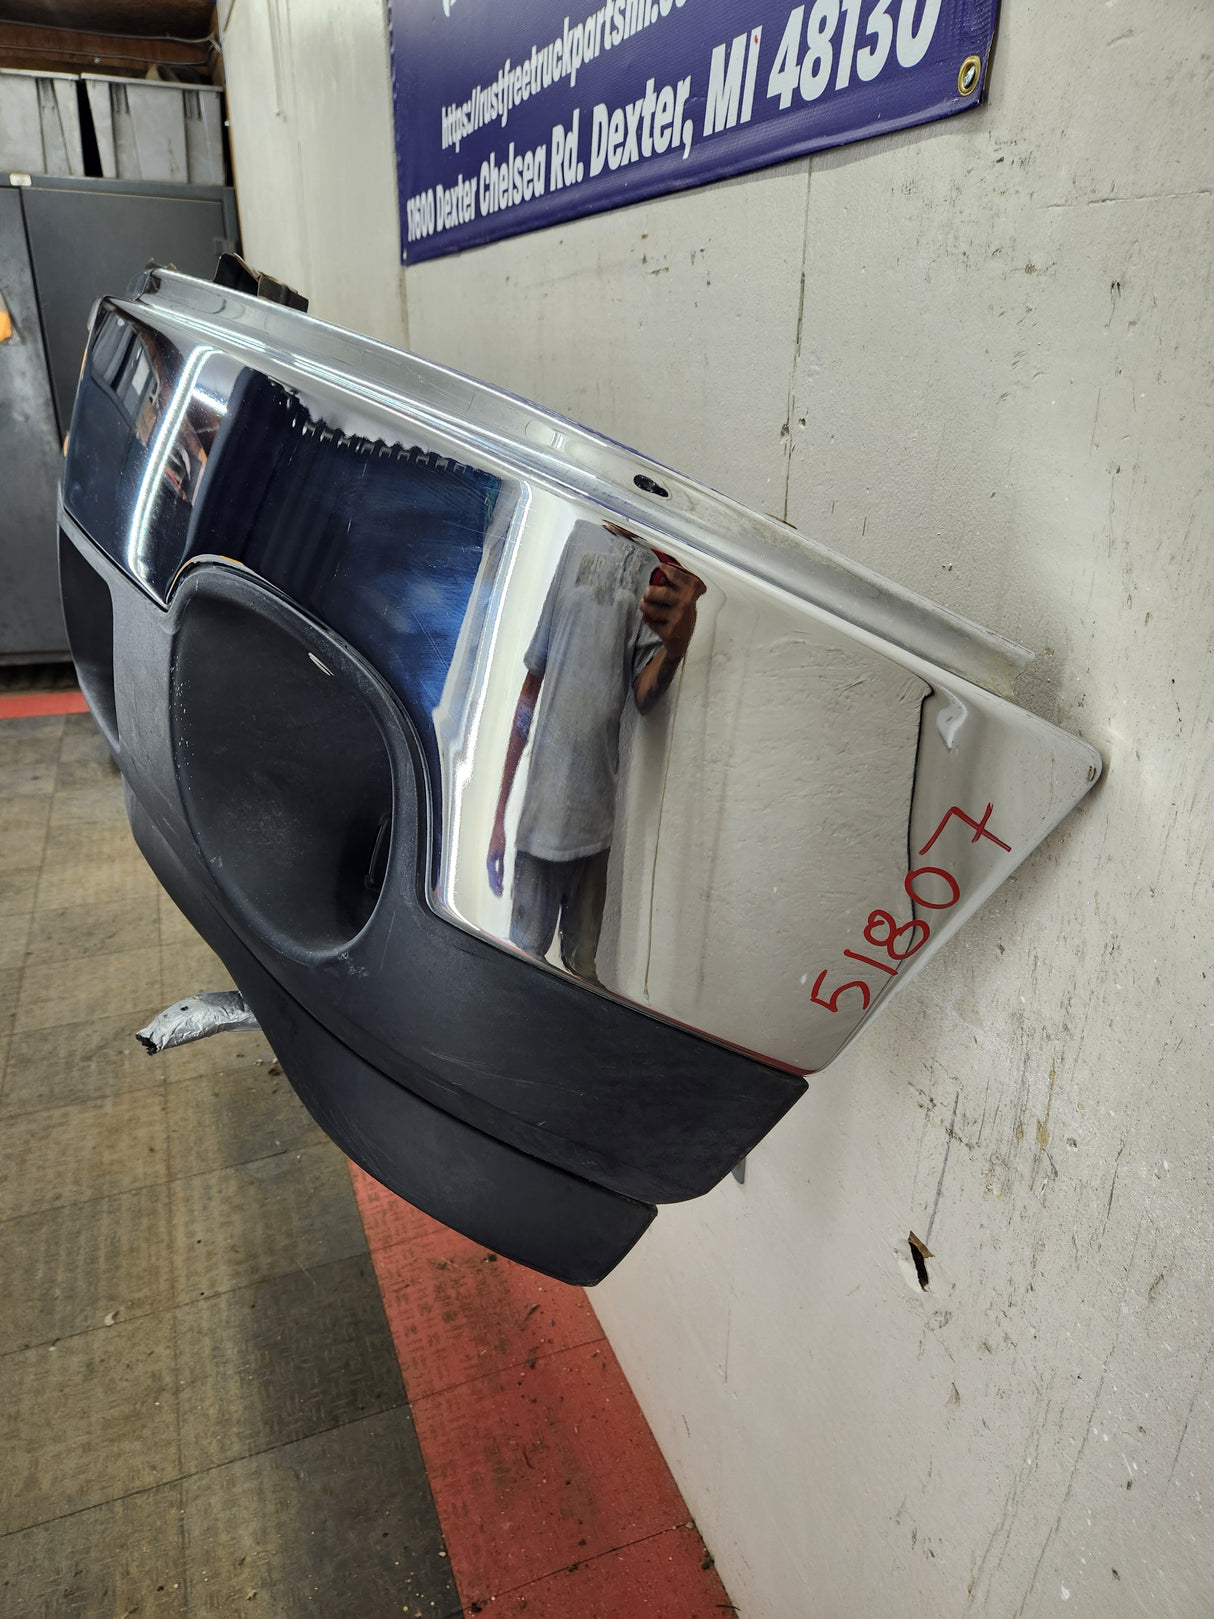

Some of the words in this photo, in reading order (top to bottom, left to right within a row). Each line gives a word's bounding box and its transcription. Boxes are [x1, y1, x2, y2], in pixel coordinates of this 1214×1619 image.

[435, 174, 478, 232] Dexter
[479, 141, 547, 217] Chelsea
[550, 109, 584, 192] Rd.
[589, 75, 694, 178] Dexter,
[702, 25, 763, 137] MI
[766, 0, 942, 110] 48130
[441, 0, 687, 153] https://rustfreetruckpartsmi.
[810, 802, 1012, 1013] 51807
